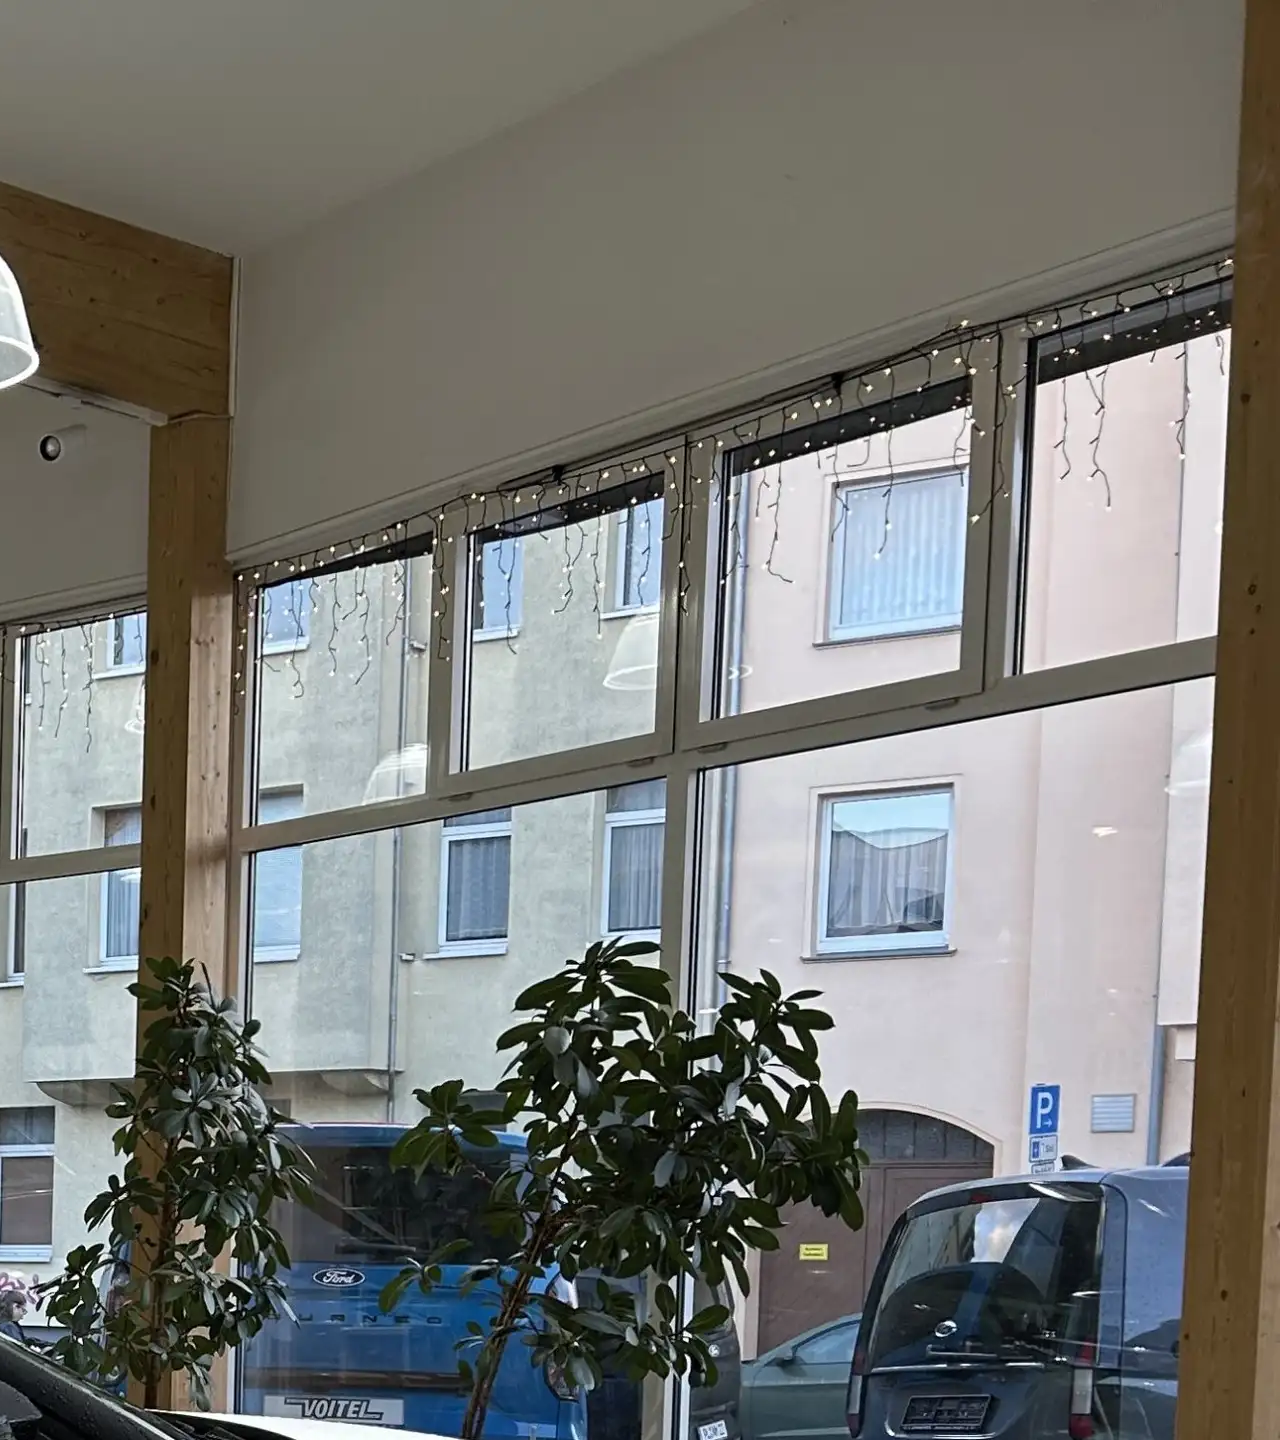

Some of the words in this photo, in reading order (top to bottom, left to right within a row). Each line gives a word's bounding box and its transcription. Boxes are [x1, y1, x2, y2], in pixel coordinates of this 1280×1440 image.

[1036, 1092, 1053, 1128] P
[319, 1270, 359, 1285] Ford
[301, 1398, 372, 1420] VOITEL
